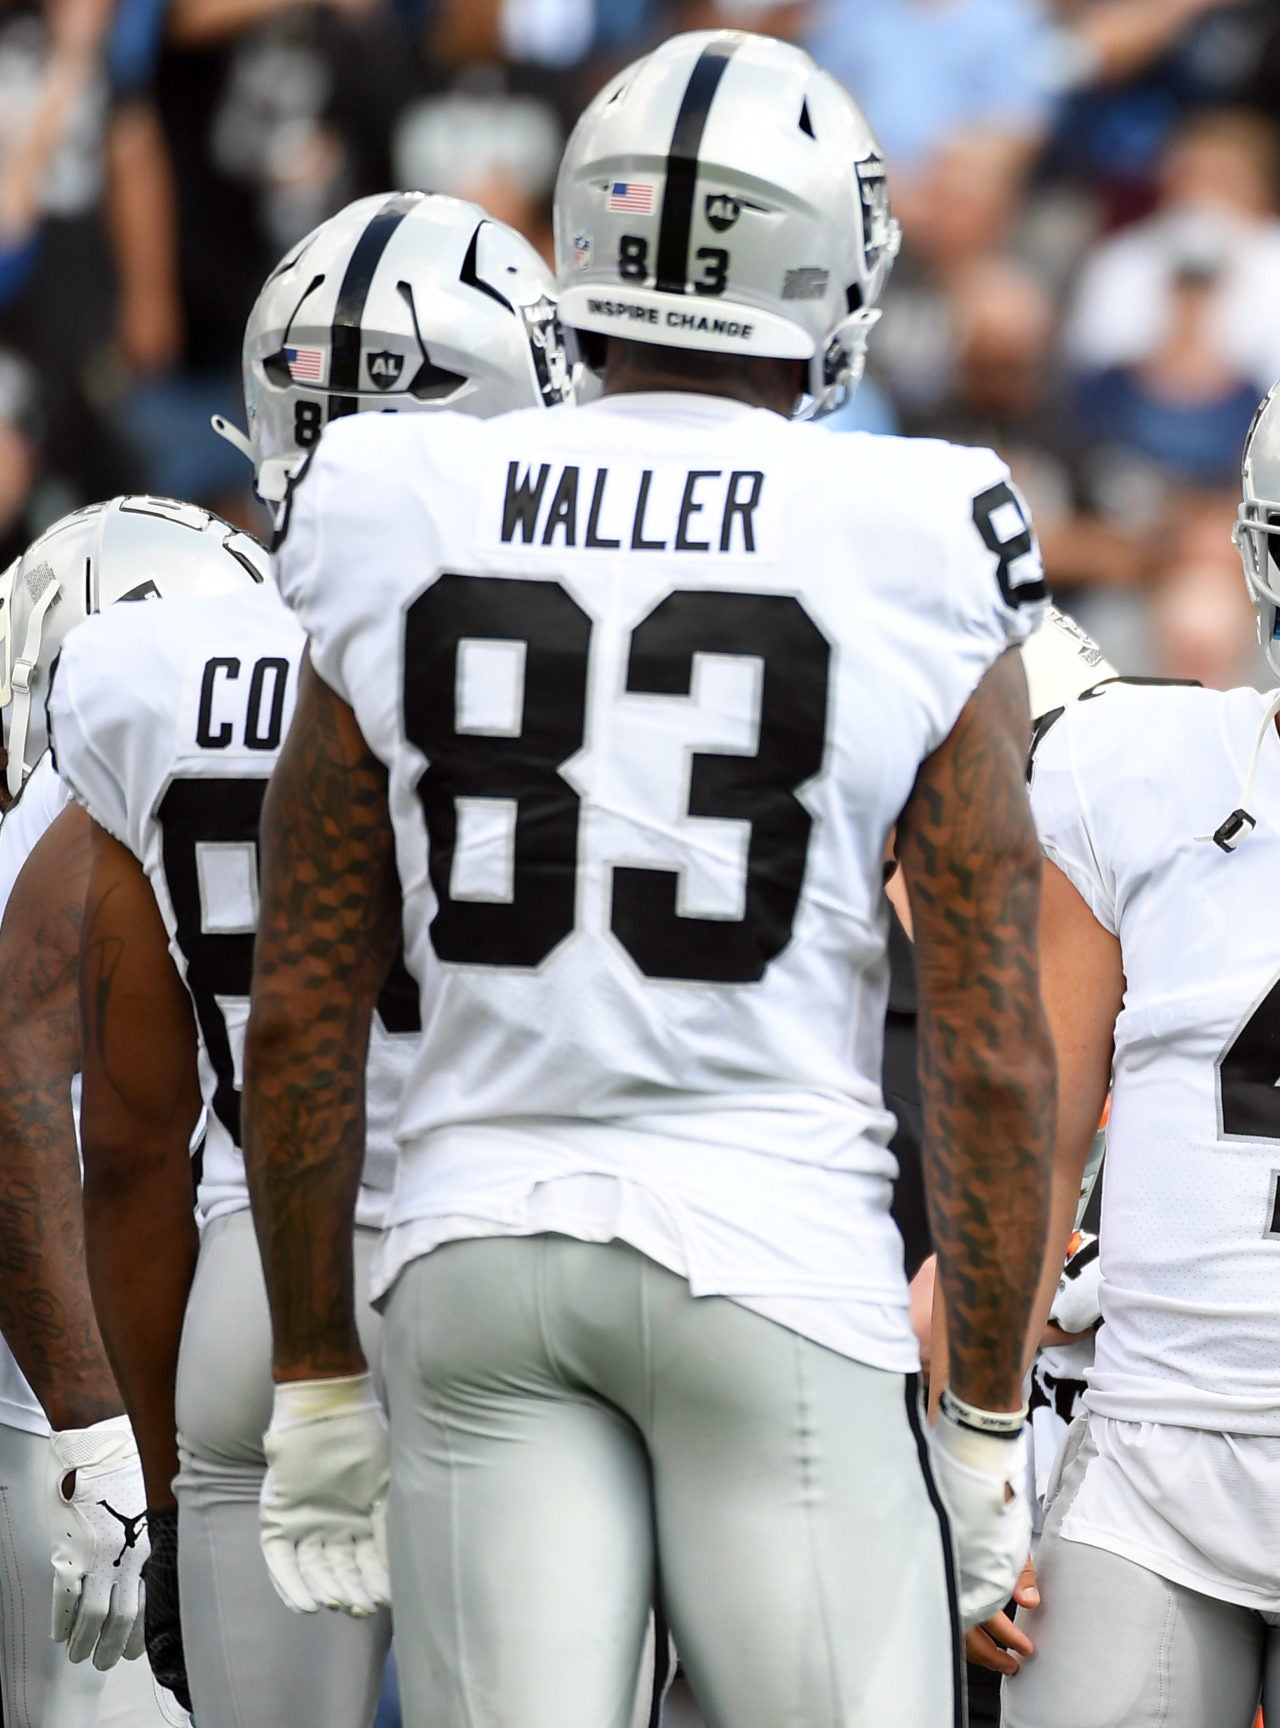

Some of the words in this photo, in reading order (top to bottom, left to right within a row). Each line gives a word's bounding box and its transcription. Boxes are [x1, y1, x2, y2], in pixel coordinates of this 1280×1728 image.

[588, 300, 659, 325] INSPIRE
[667, 312, 755, 340] CHANGE
[371, 358, 400, 376] AL
[501, 460, 766, 553] WALLER
[402, 572, 833, 984] 83
